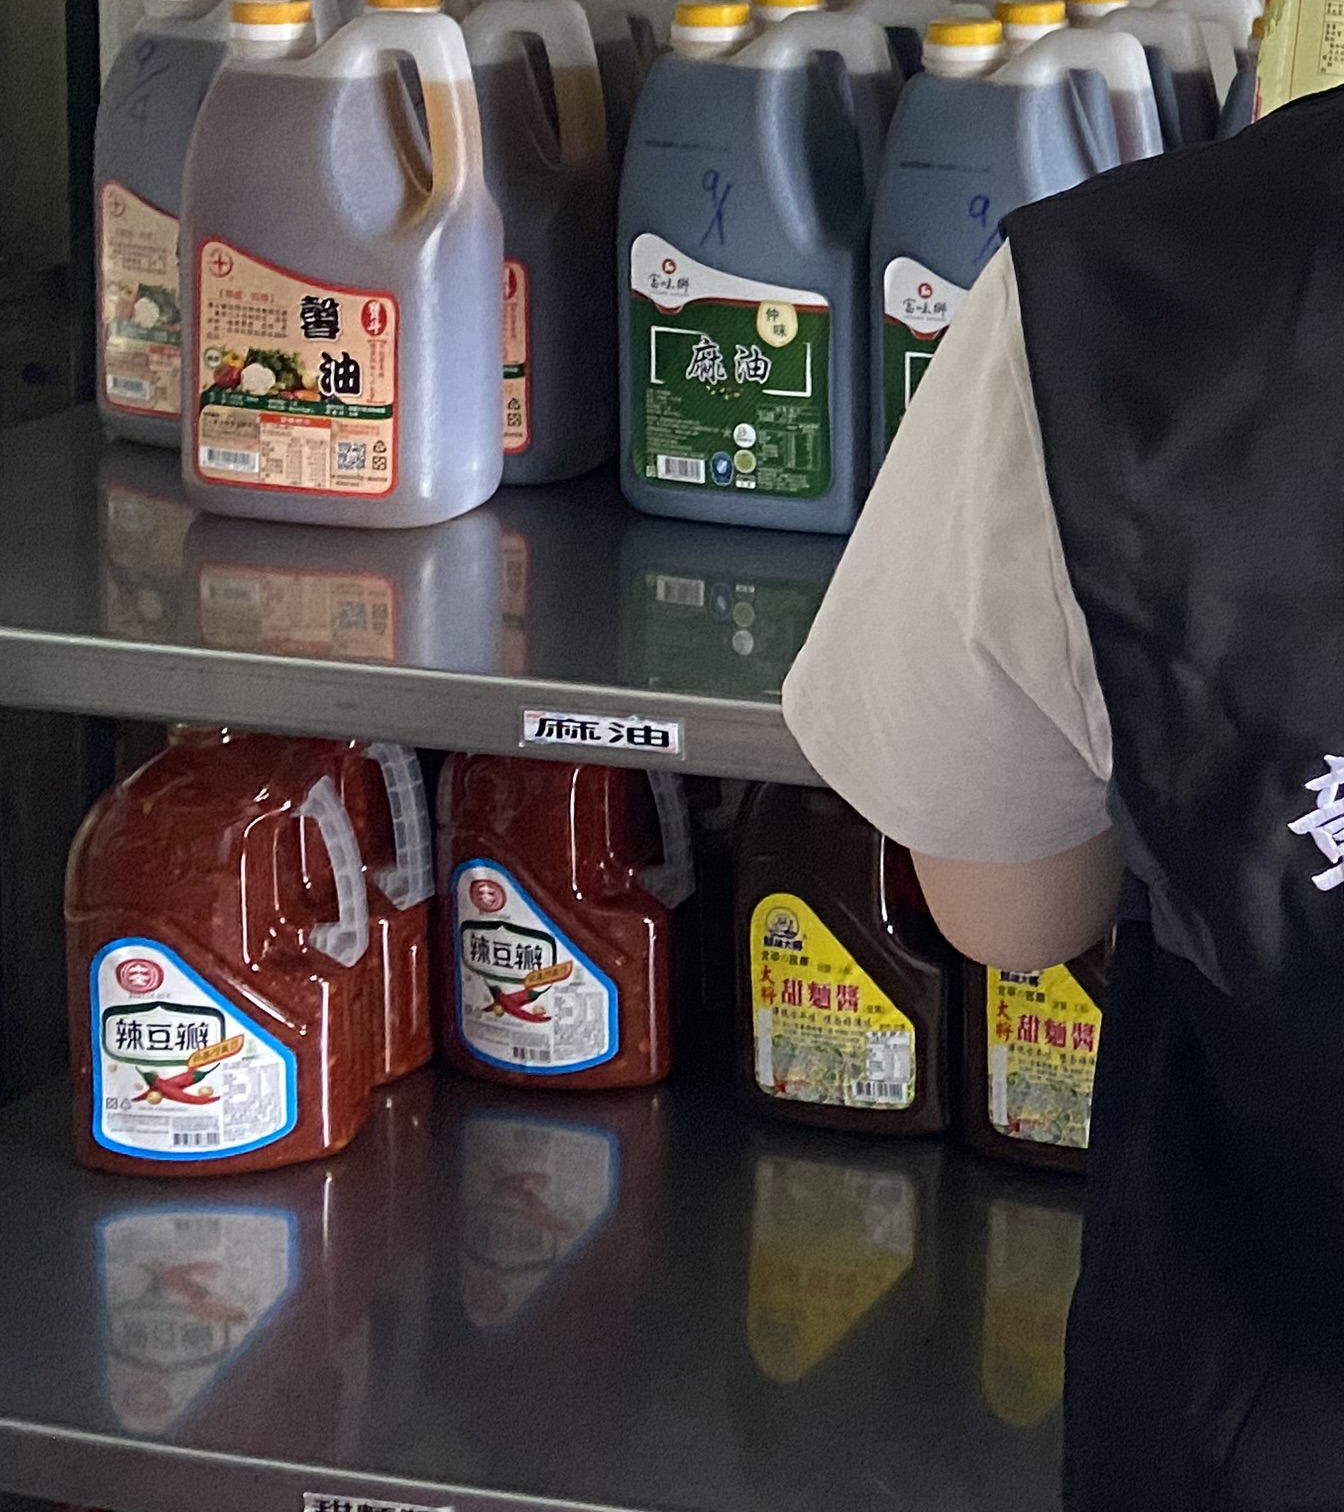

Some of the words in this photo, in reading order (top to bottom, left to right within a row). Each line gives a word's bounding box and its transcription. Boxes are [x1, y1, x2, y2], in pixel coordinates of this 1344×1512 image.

[686, 334, 773, 385] 麻油
[534, 717, 672, 749] 麻油
[469, 933, 544, 971] 辣豆瓣
[115, 1017, 210, 1052] 辣豆瓣
